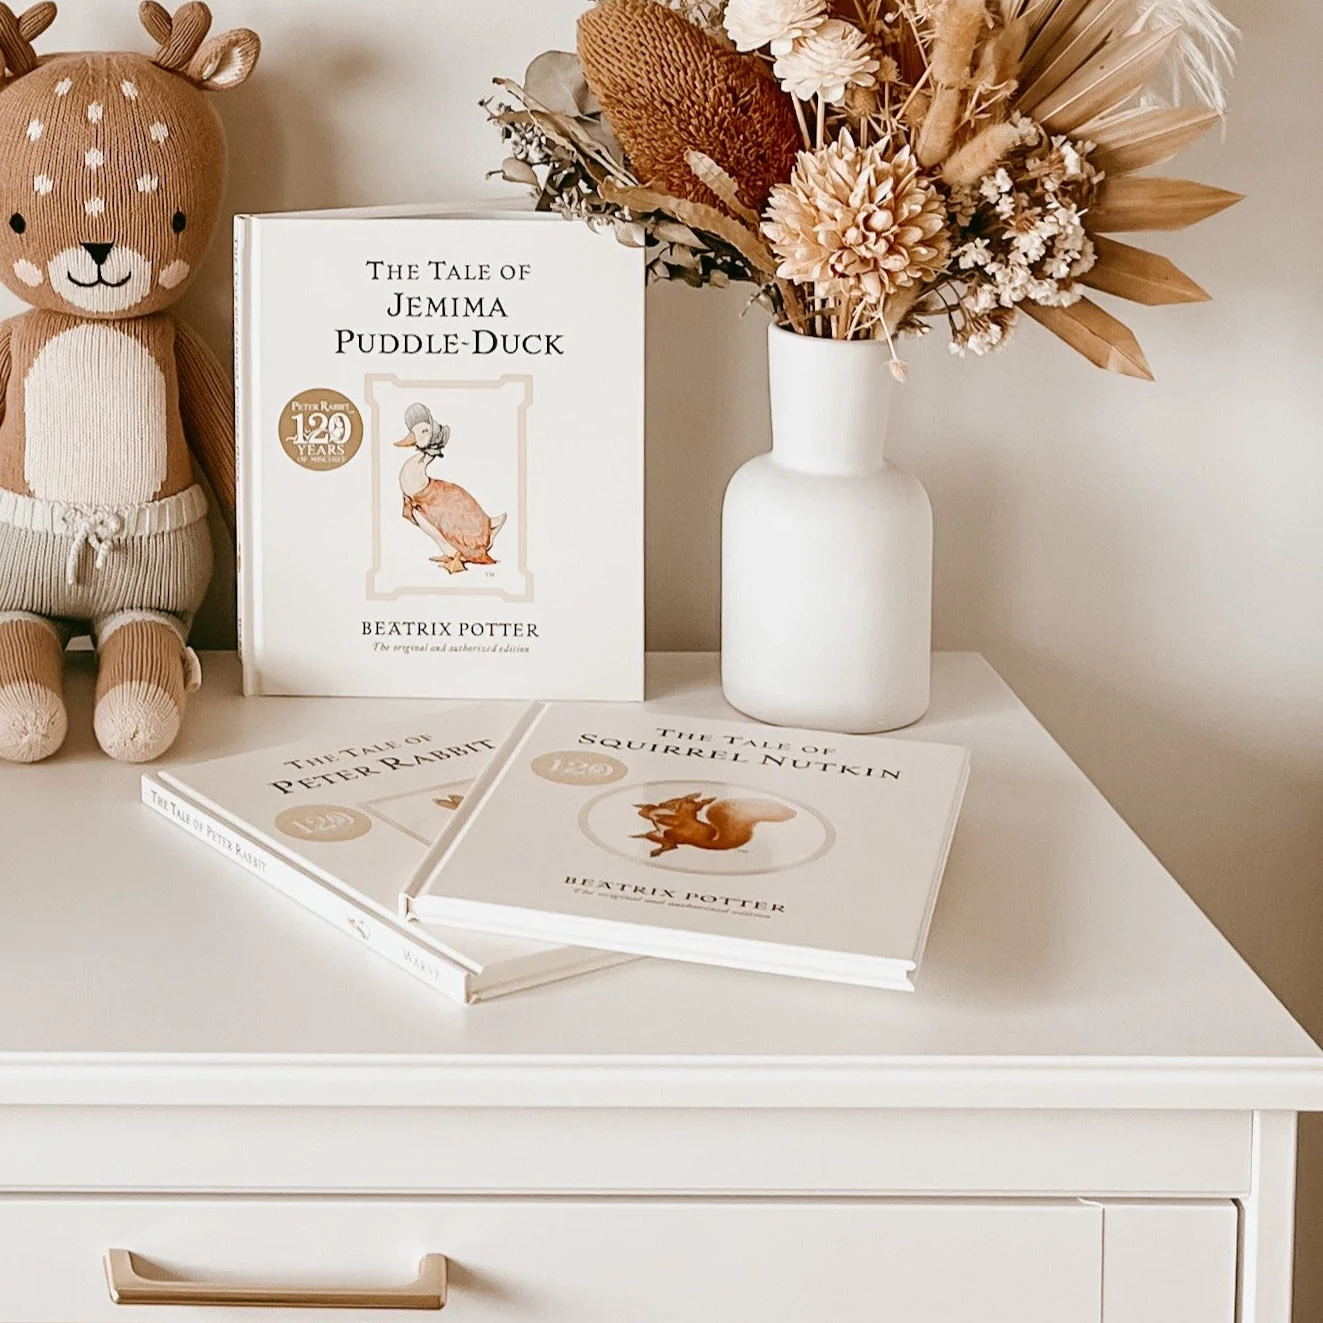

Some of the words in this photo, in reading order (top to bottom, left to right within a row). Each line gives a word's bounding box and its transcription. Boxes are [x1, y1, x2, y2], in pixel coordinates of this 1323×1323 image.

[366, 260, 420, 281] THE
[428, 260, 491, 281] TALE
[500, 264, 531, 281] OF
[387, 292, 508, 318] JEMIMA
[334, 329, 565, 355] PUDDLE-DUCK
[291, 412, 352, 444] 120
[296, 444, 345, 456] YEARS
[361, 620, 452, 637] BEATRIX
[459, 621, 540, 638] POTTER
[372, 642, 390, 652] The
[393, 643, 428, 655] original
[429, 643, 447, 653] and
[655, 727, 712, 743] THE
[723, 735, 792, 752] TALE
[801, 745, 838, 756] OF
[268, 766, 381, 795] PETER
[378, 738, 497, 771] RABBIT
[283, 753, 339, 771] THE
[338, 740, 402, 759] TALE
[544, 755, 614, 778] 120
[577, 733, 750, 763] SQUIRREL
[761, 753, 902, 780] NUTKIN
[564, 875, 676, 899] BEATRIX
[685, 892, 786, 914] POTTER
